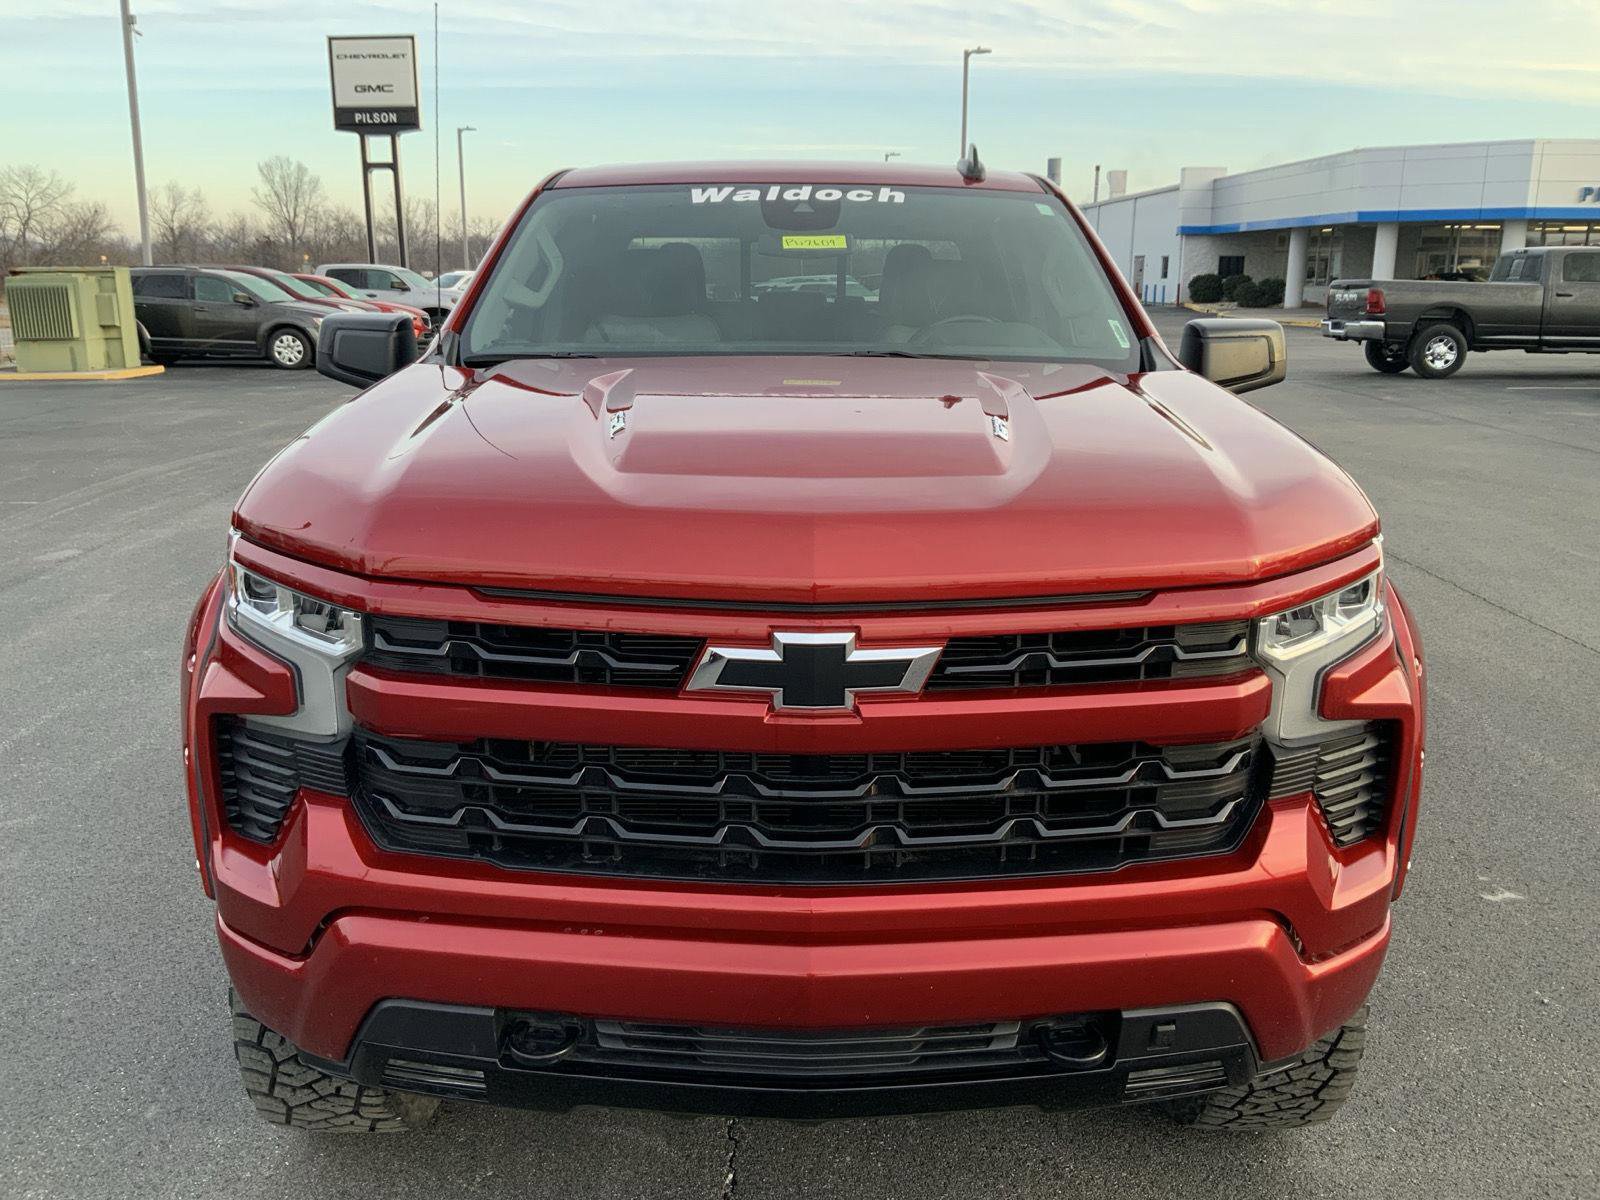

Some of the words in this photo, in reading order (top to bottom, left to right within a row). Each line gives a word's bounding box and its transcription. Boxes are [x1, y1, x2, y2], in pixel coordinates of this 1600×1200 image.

[354, 84, 395, 93] GMC
[354, 112, 398, 124] PILSON
[691, 185, 906, 204] Waldoch
